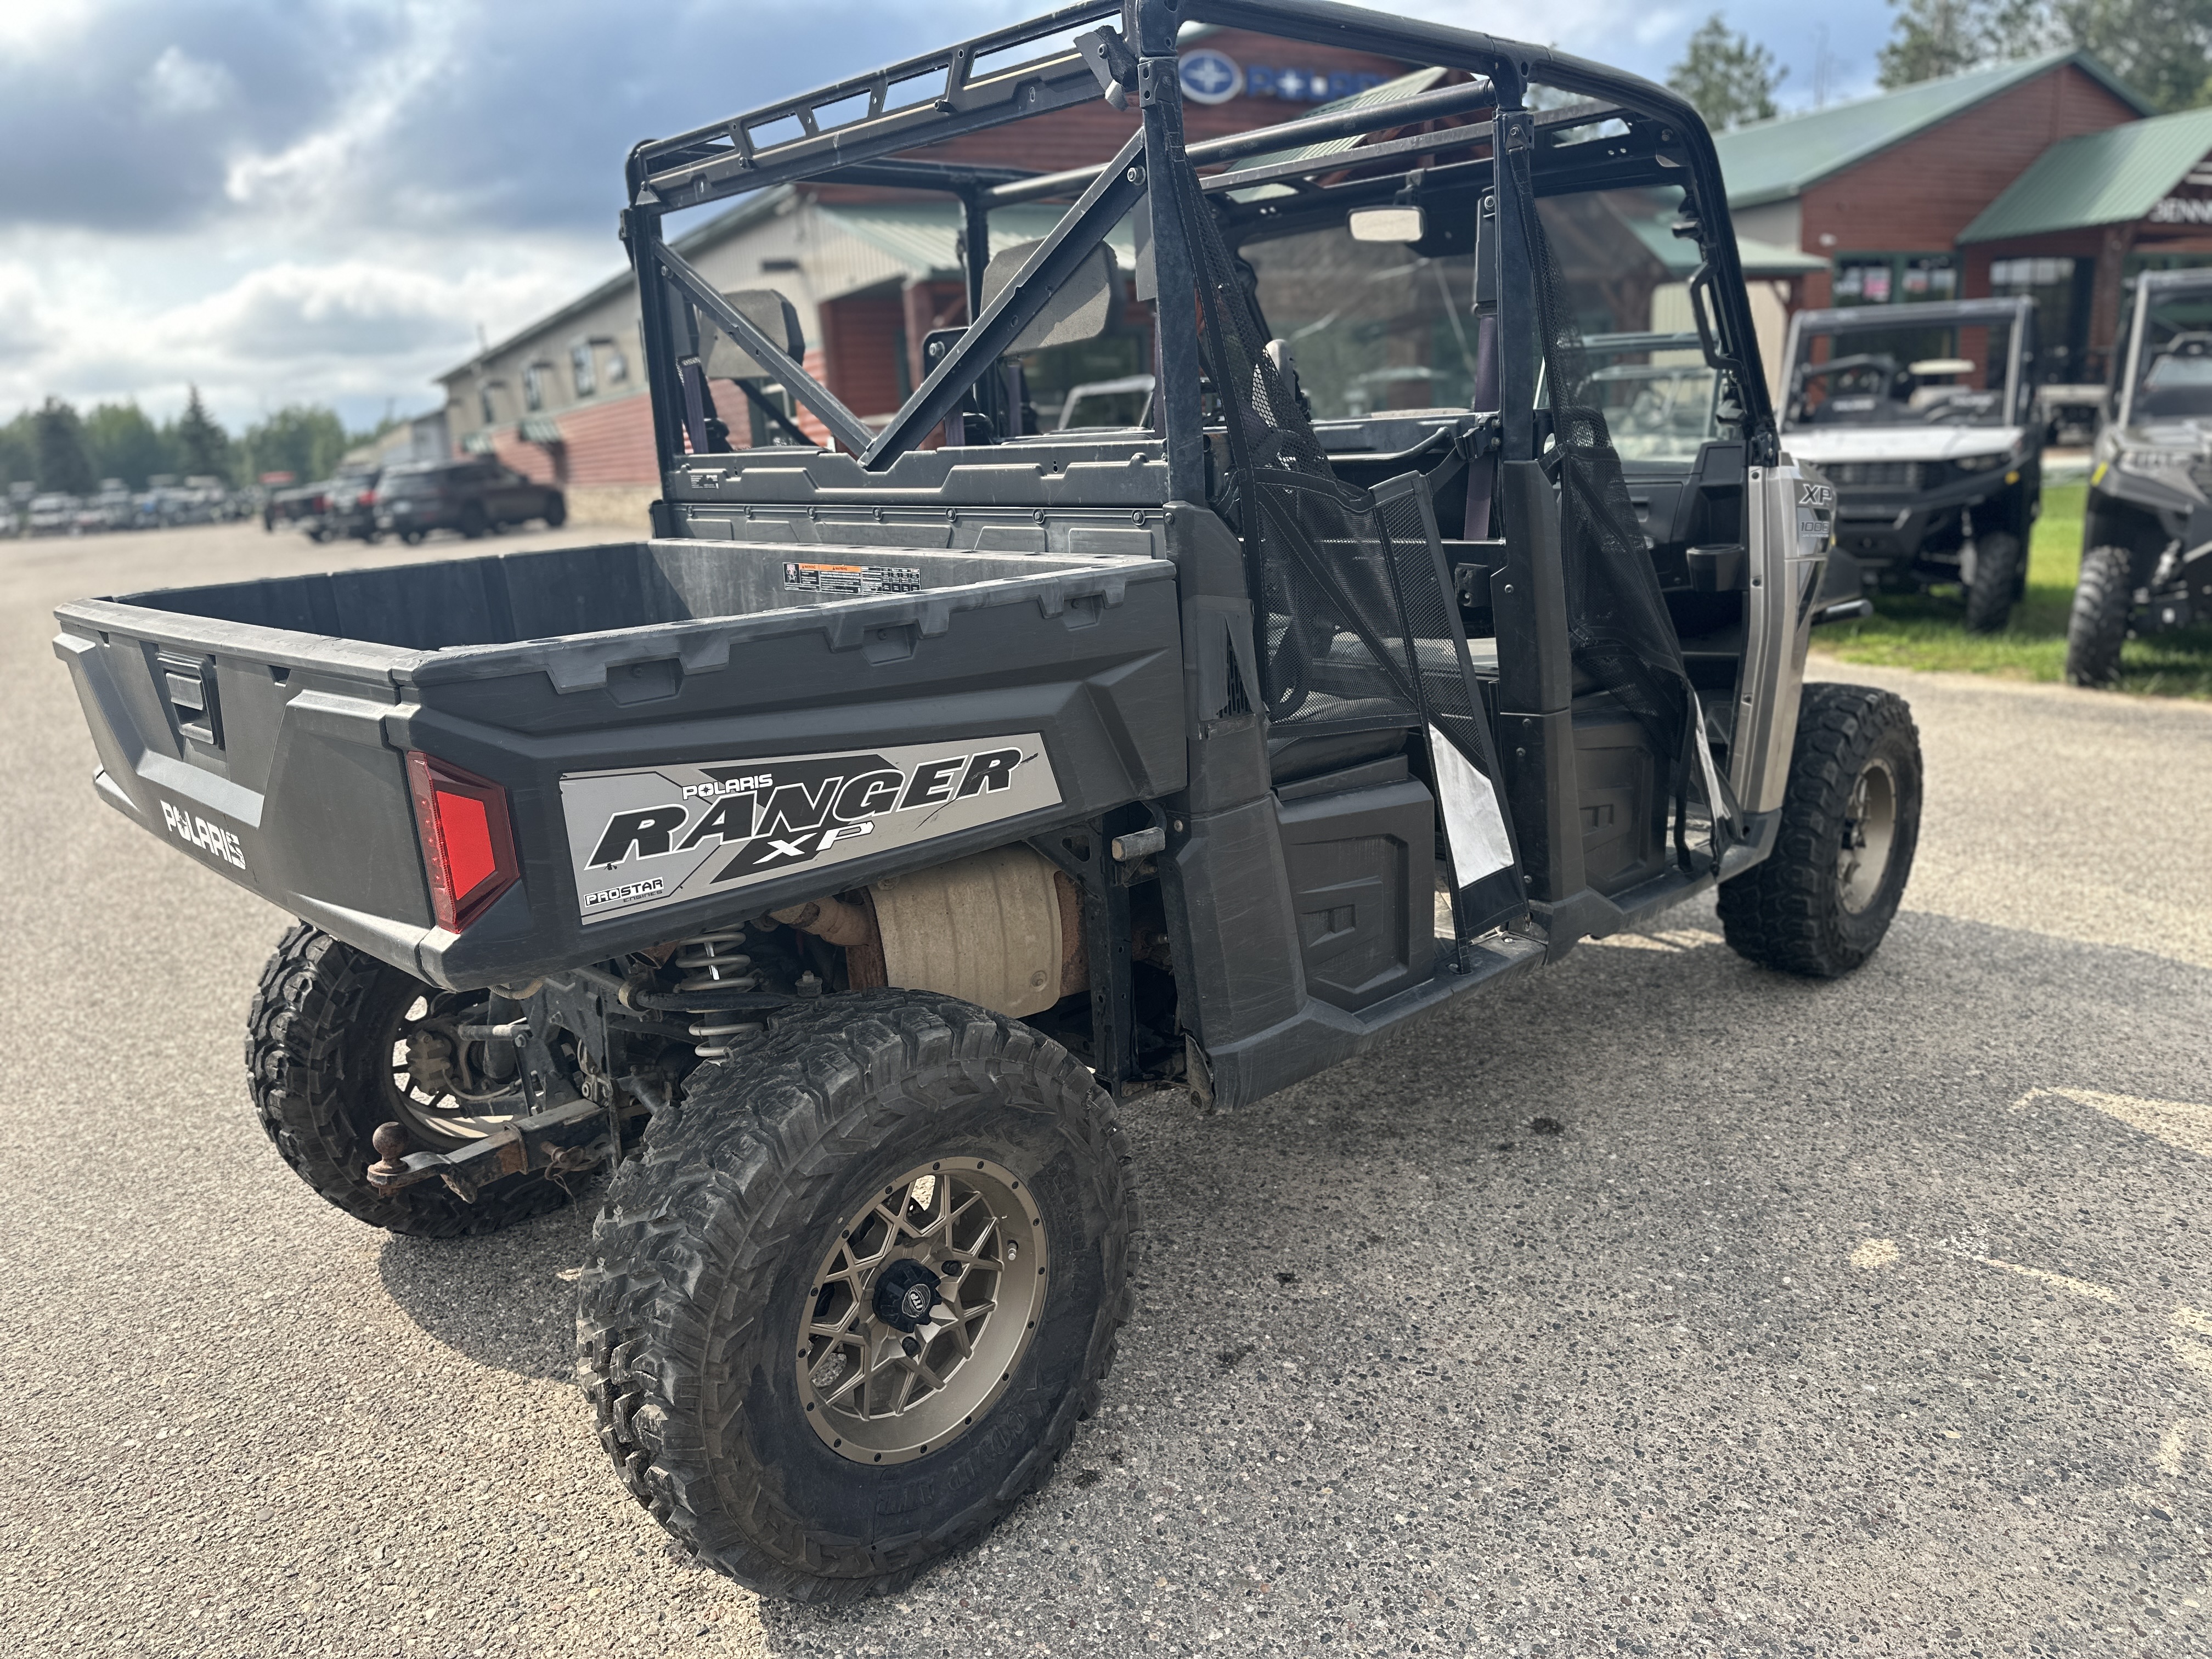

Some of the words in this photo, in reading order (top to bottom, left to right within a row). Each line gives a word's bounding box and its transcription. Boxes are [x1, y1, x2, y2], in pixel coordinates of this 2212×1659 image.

[1798, 483, 1832, 505] XP
[1801, 521, 1830, 533] 1000
[682, 773, 773, 800] POLARIS
[583, 747, 1024, 871] RANGER
[160, 799, 246, 870] POLARIS
[752, 820, 876, 865] XP
[584, 877, 664, 907] PROSTAR
[623, 889, 663, 903] ENGINES
[910, 1293, 923, 1310] ITP
